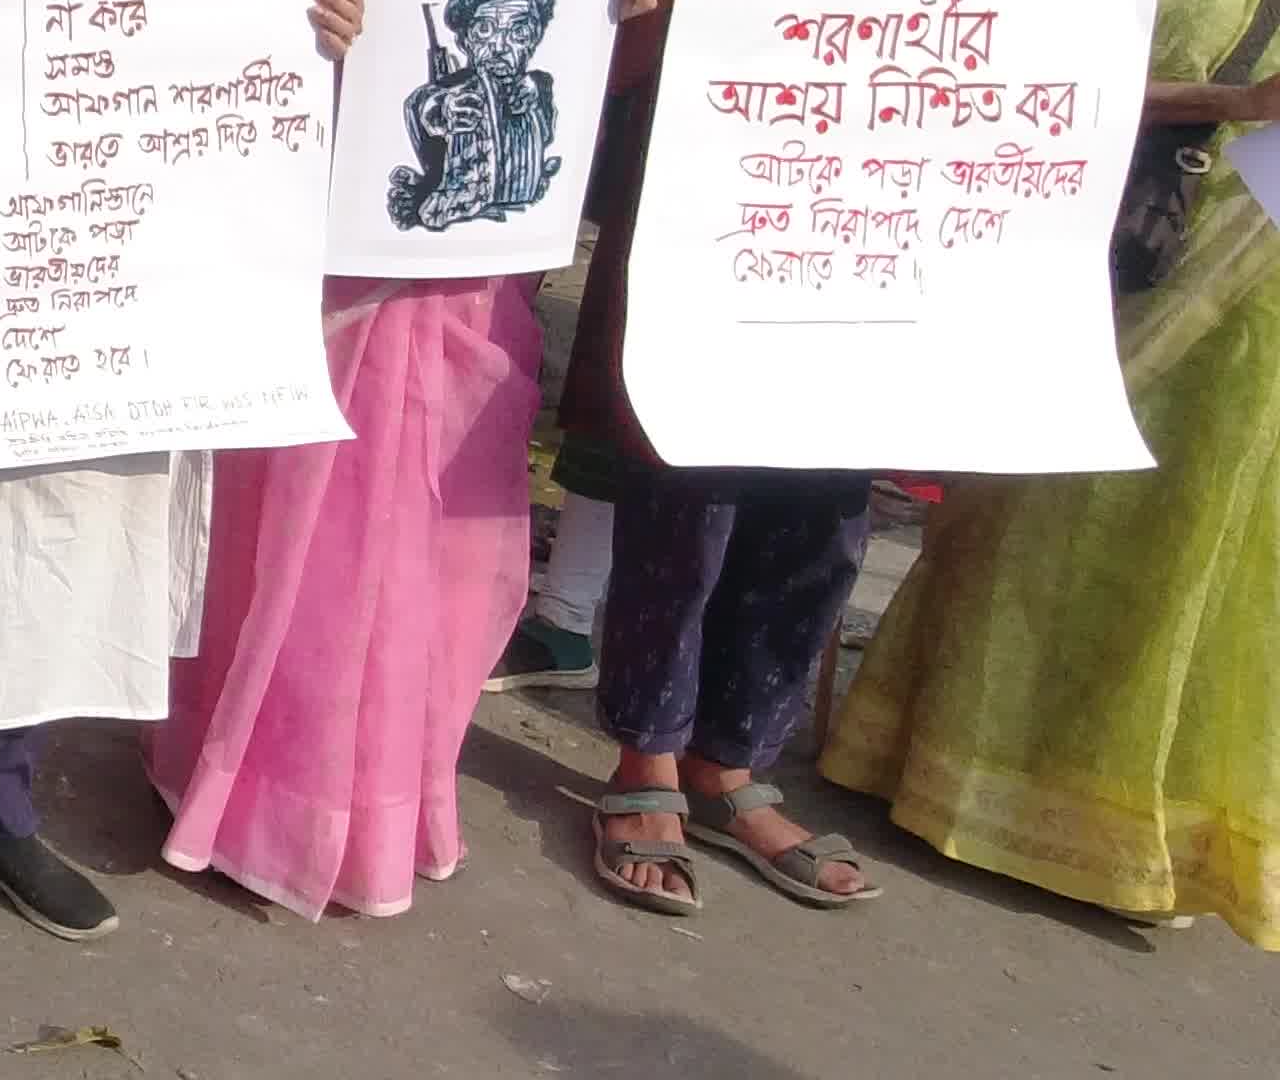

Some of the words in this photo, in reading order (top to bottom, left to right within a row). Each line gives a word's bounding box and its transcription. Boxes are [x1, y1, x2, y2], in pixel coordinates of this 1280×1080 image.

[45, 0, 83, 40] না
[40, 85, 158, 124] আফগান
[706, 80, 847, 134] আশ্রয়
[866, 64, 1007, 131] নিশ্চিত
[47, 133, 123, 169] ভারতে
[740, 140, 843, 194] আটকে
[939, 142, 1088, 199] ভারতীয়দের
[810, 198, 922, 251] নিরাপদে
[939, 207, 1012, 249] দেশে
[733, 248, 835, 291] ফেরাতে
